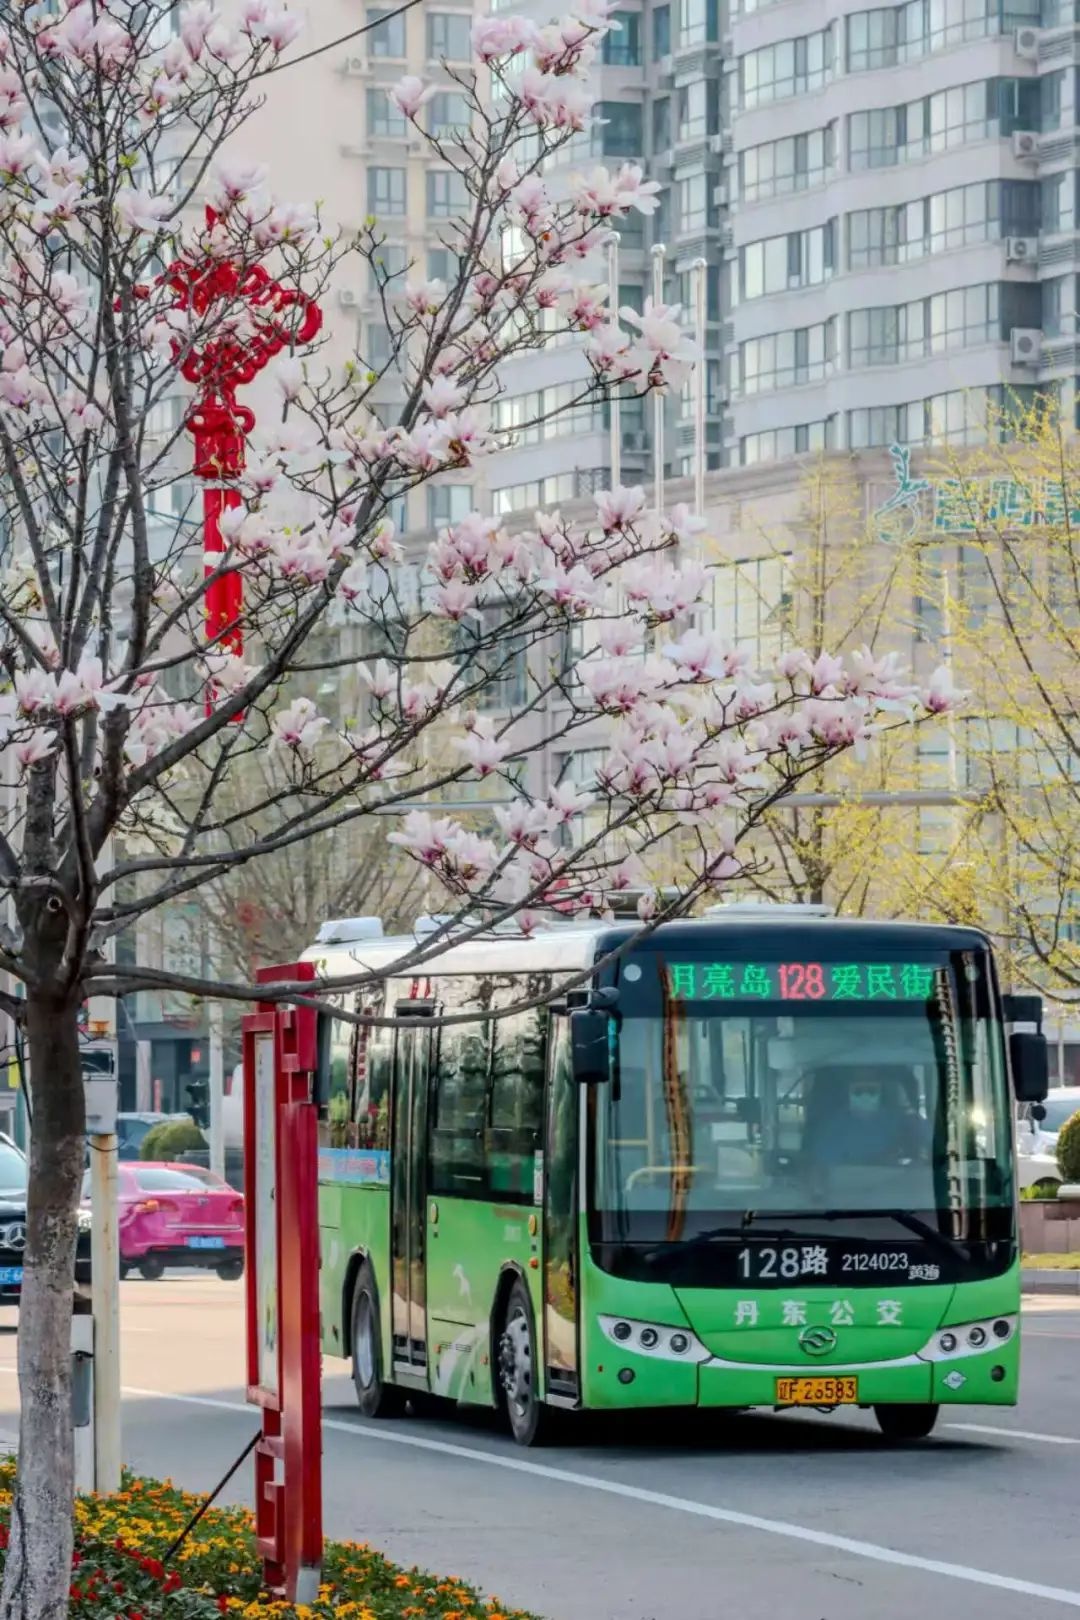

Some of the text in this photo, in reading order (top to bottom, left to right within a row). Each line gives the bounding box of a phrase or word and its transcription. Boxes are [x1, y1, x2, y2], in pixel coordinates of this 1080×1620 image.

[669, 963, 933, 999] 月亮岛 128 爱民街
[738, 1245, 909, 1278] 128路 2124023
[734, 1299, 902, 1326] 丹东公交
